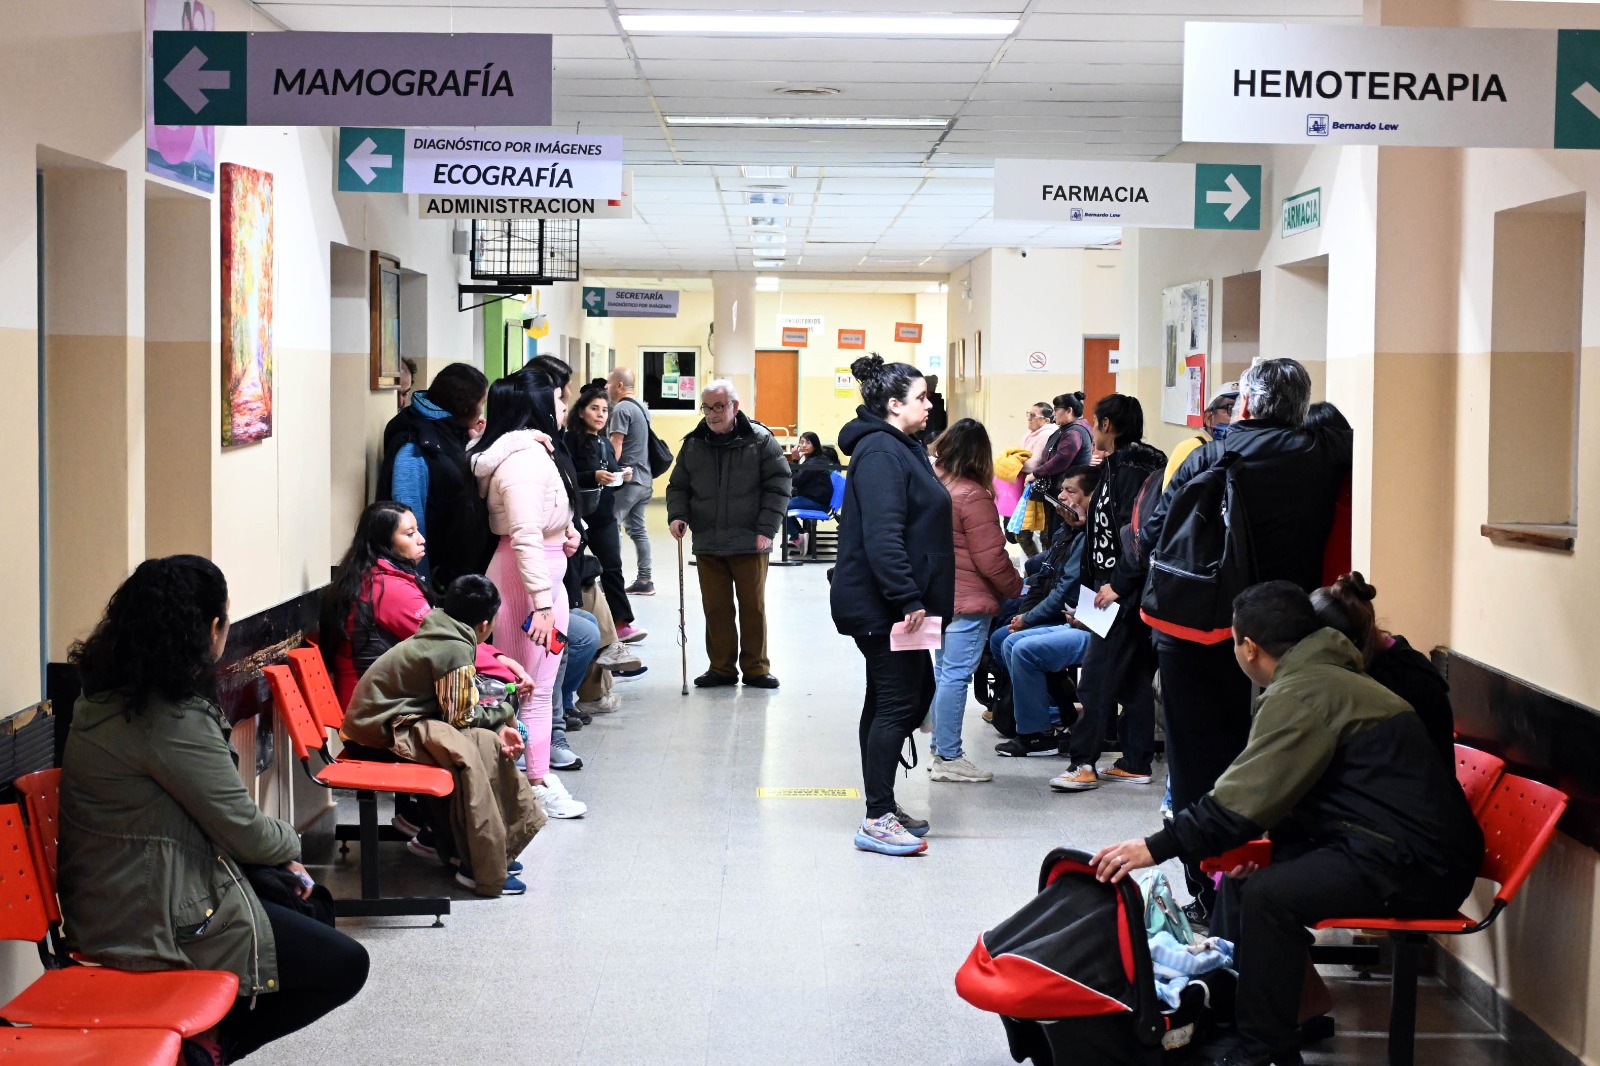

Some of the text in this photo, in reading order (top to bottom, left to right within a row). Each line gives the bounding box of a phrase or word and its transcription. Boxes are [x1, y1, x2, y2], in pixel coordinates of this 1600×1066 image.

[273, 62, 514, 97] MAMOGRAFÍA
[1233, 69, 1508, 103] HEMOTERAPIA
[1332, 121, 1399, 131] Bernardo Lew
[413, 137, 602, 156] DIAGNÓSTICO POR IMÁGENES
[433, 162, 574, 189] ECOGRAFÍA
[1042, 184, 1149, 203] FARMACIA
[426, 198, 595, 214] ADMINISTRACION
[1283, 198, 1318, 231] FARMACIA
[615, 291, 664, 301] SECRETARÍA
